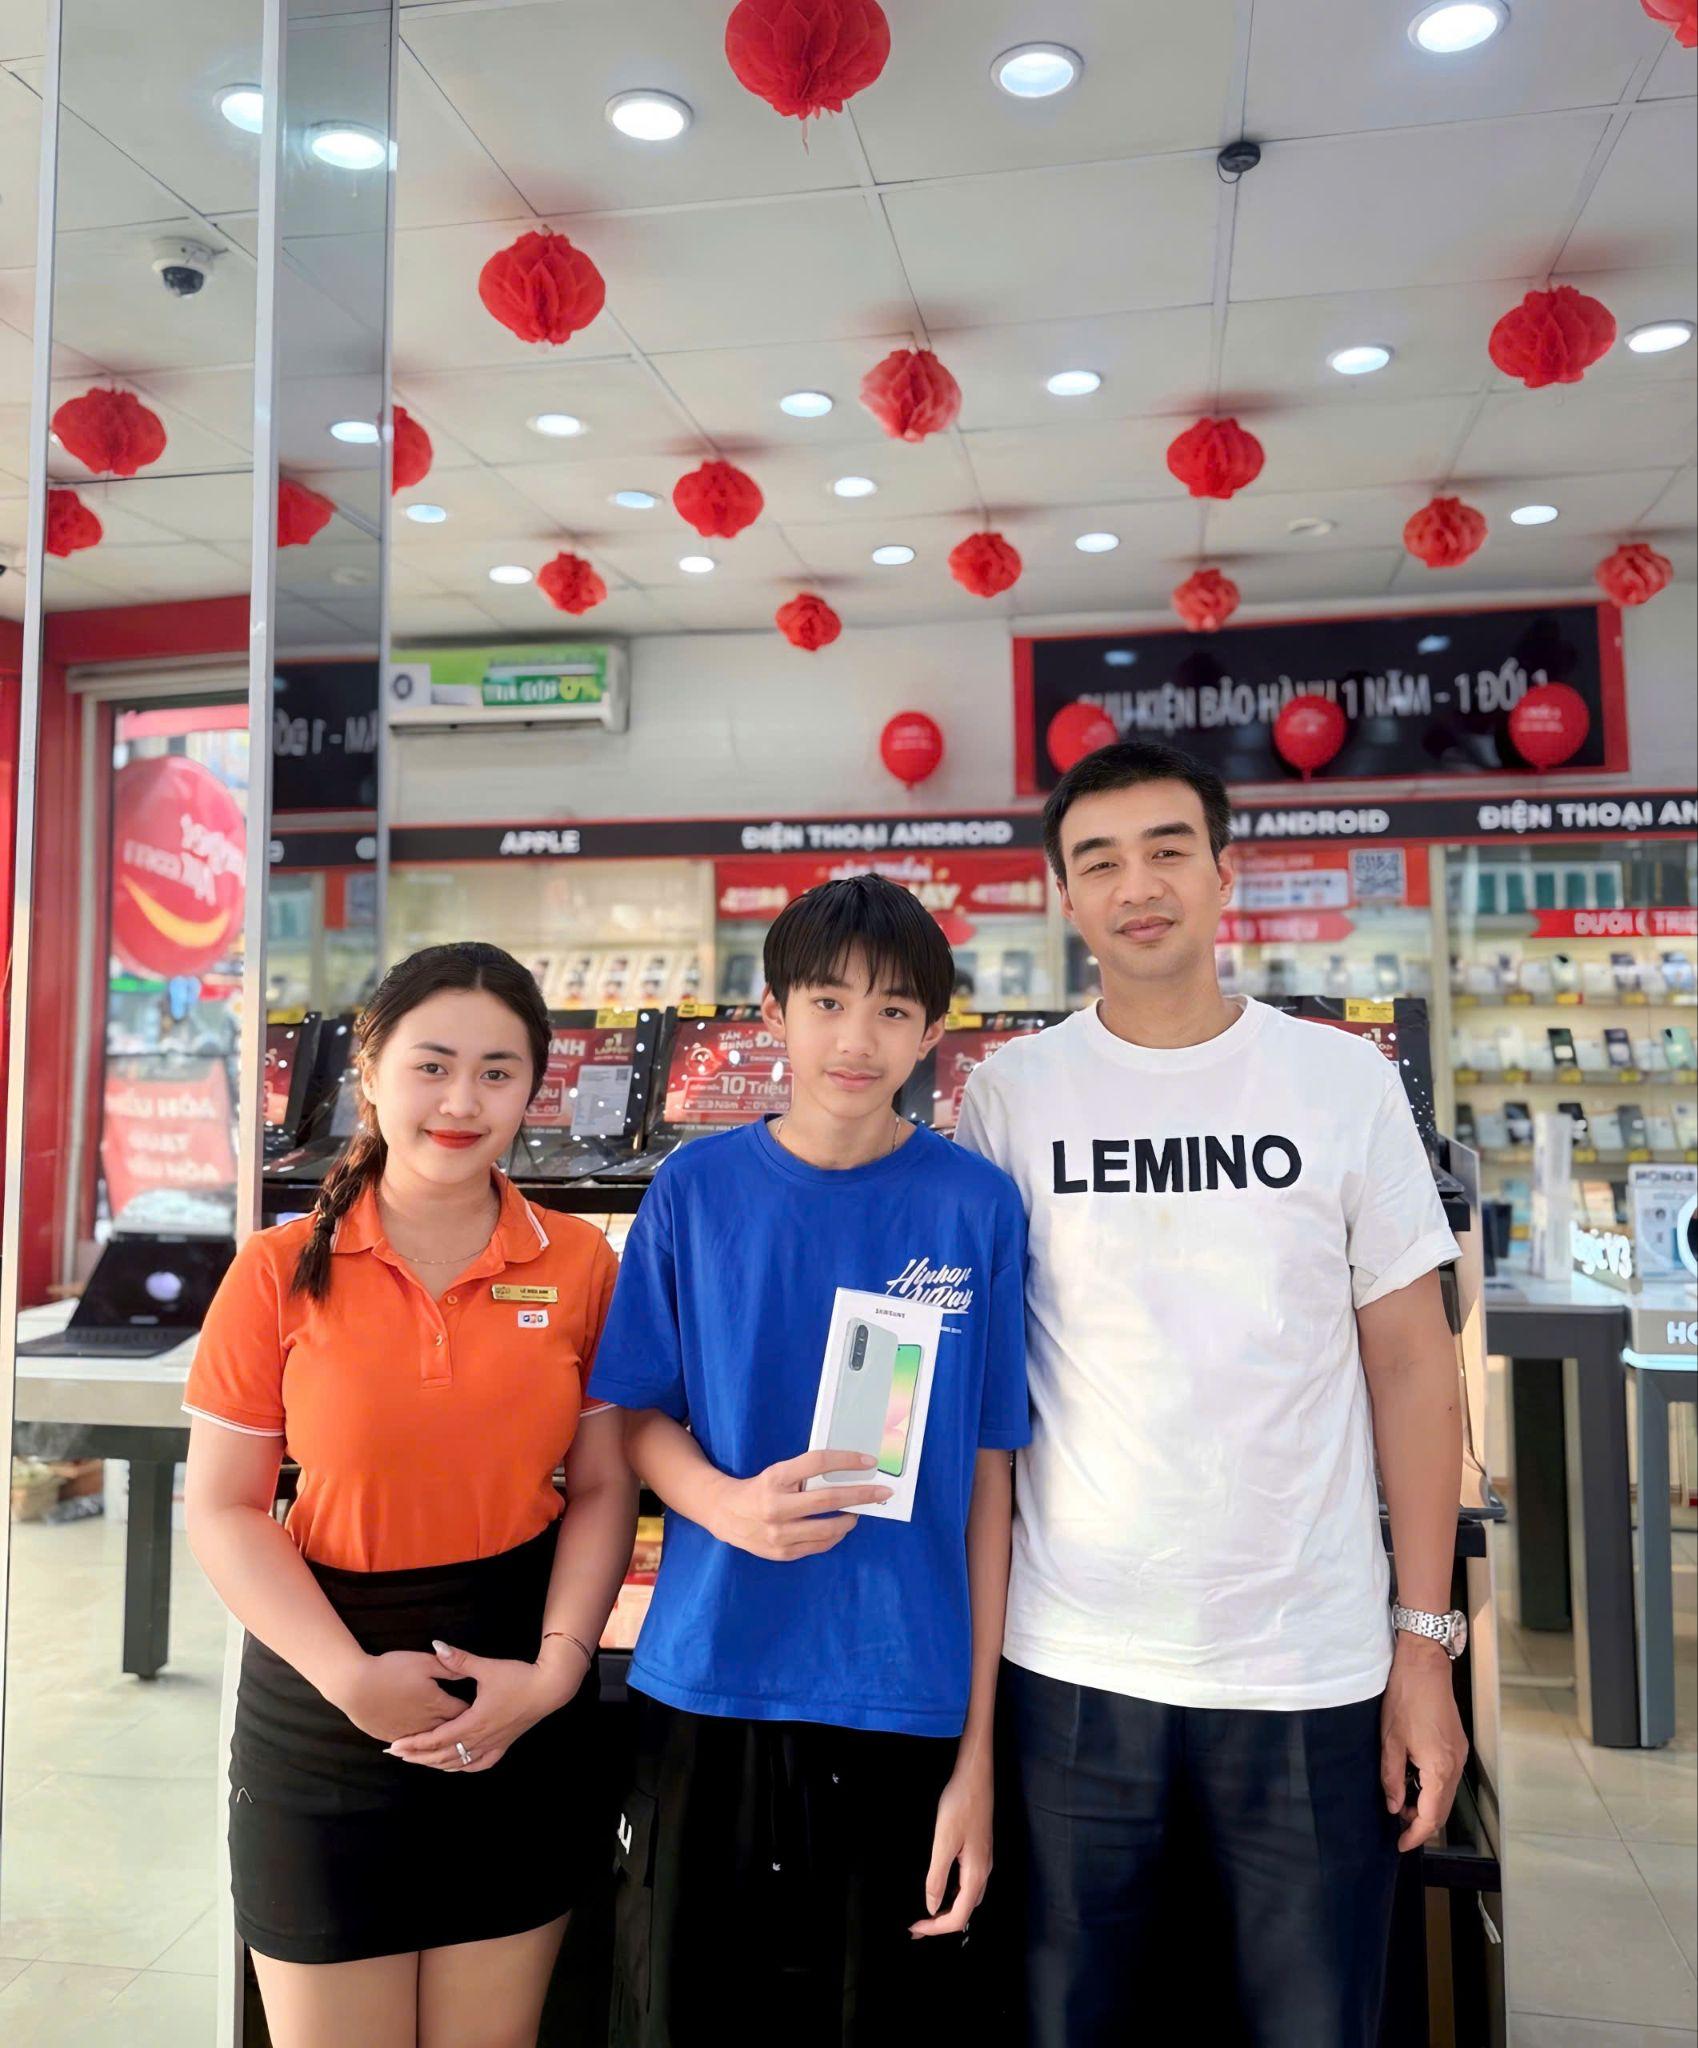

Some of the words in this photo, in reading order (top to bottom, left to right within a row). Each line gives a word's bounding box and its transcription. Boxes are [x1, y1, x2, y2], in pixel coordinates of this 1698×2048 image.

[1341, 679, 1358, 719] 1
[1454, 673, 1471, 714] 1
[1255, 808, 1390, 837] ANDROID
[1478, 799, 1552, 833] ĐIỆN
[1556, 801, 1653, 830] THOẠI
[499, 829, 580, 855] APPLE
[742, 821, 805, 853] ĐIỆN
[806, 822, 888, 852] THOẠI
[891, 820, 1013, 847] ANDROID
[721, 1075, 745, 1095] 10
[1052, 1134, 1303, 1194] LEMINO
